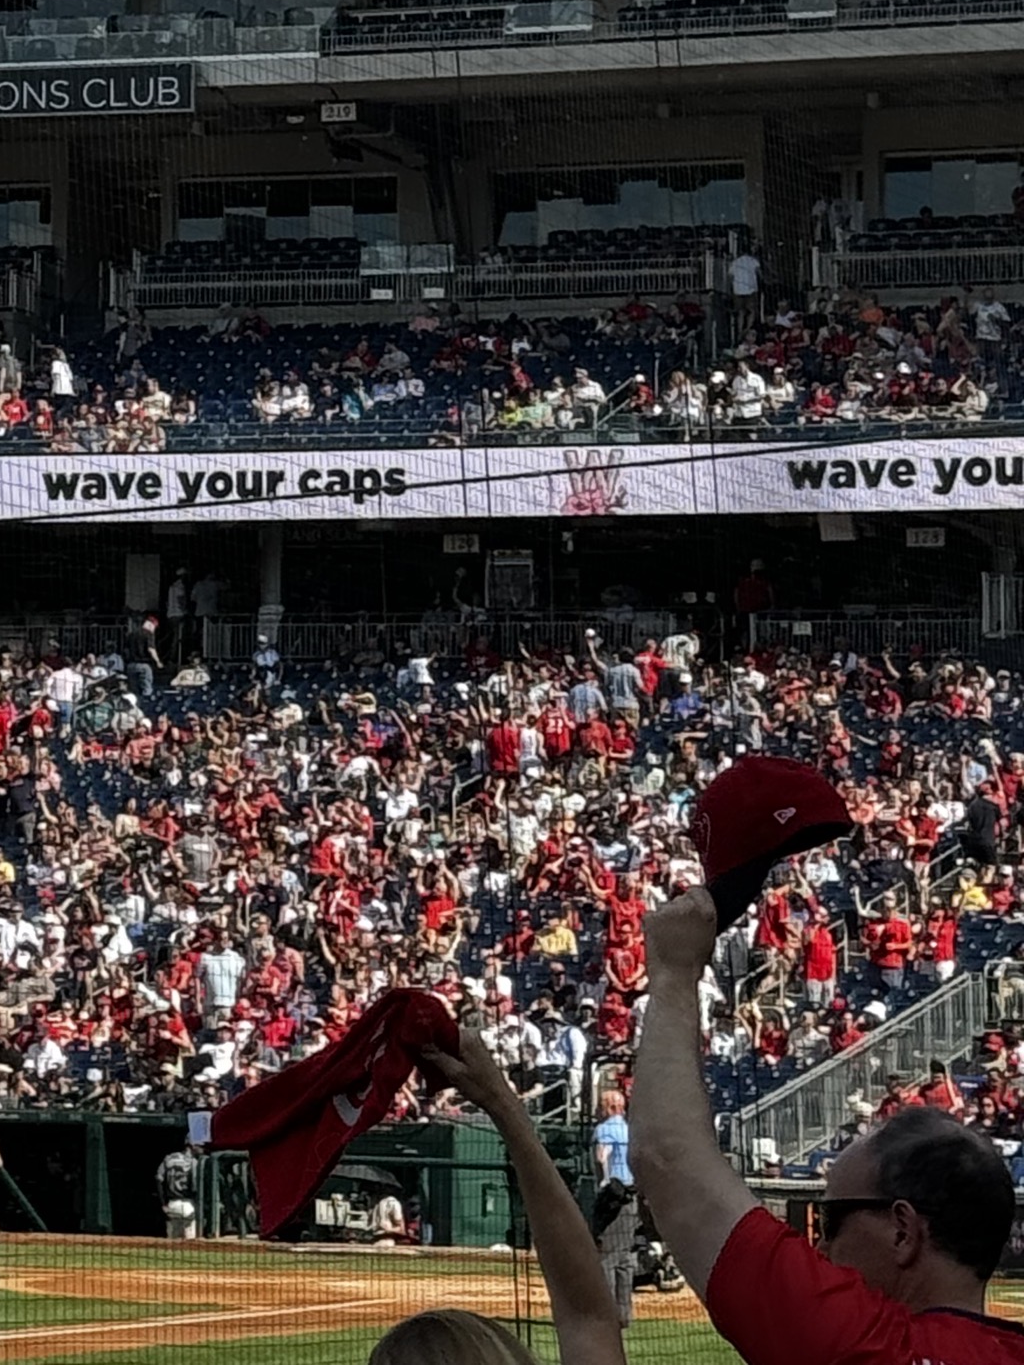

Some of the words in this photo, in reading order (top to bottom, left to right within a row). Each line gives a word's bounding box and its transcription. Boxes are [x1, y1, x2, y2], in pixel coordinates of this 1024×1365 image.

[82, 76, 181, 108] CLUB
[42, 472, 162, 501] wave
[177, 469, 285, 504] your
[298, 466, 407, 503] caps
[787, 459, 917, 490] wave
